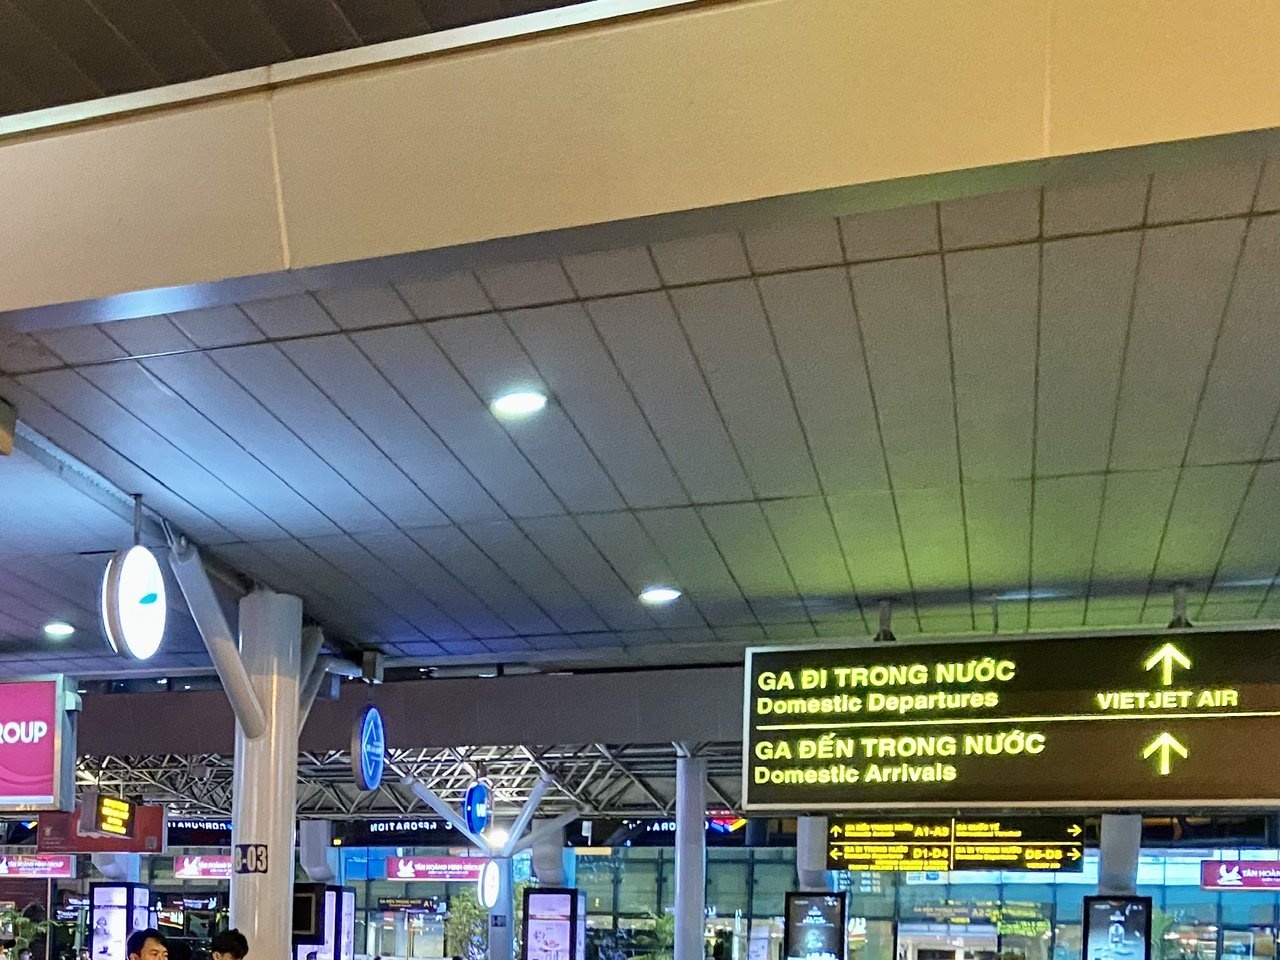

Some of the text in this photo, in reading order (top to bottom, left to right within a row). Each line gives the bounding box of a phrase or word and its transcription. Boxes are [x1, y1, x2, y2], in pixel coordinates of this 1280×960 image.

[757, 657, 1016, 691] GA ĐI TRONG NƯỚC
[757, 691, 999, 715] Domestic Departures
[1097, 689, 1238, 710] VIETJET AIR
[754, 730, 1046, 760] GA ĐẾN TRONG NƯỚC
[754, 762, 957, 784] Domestic Arrivals
